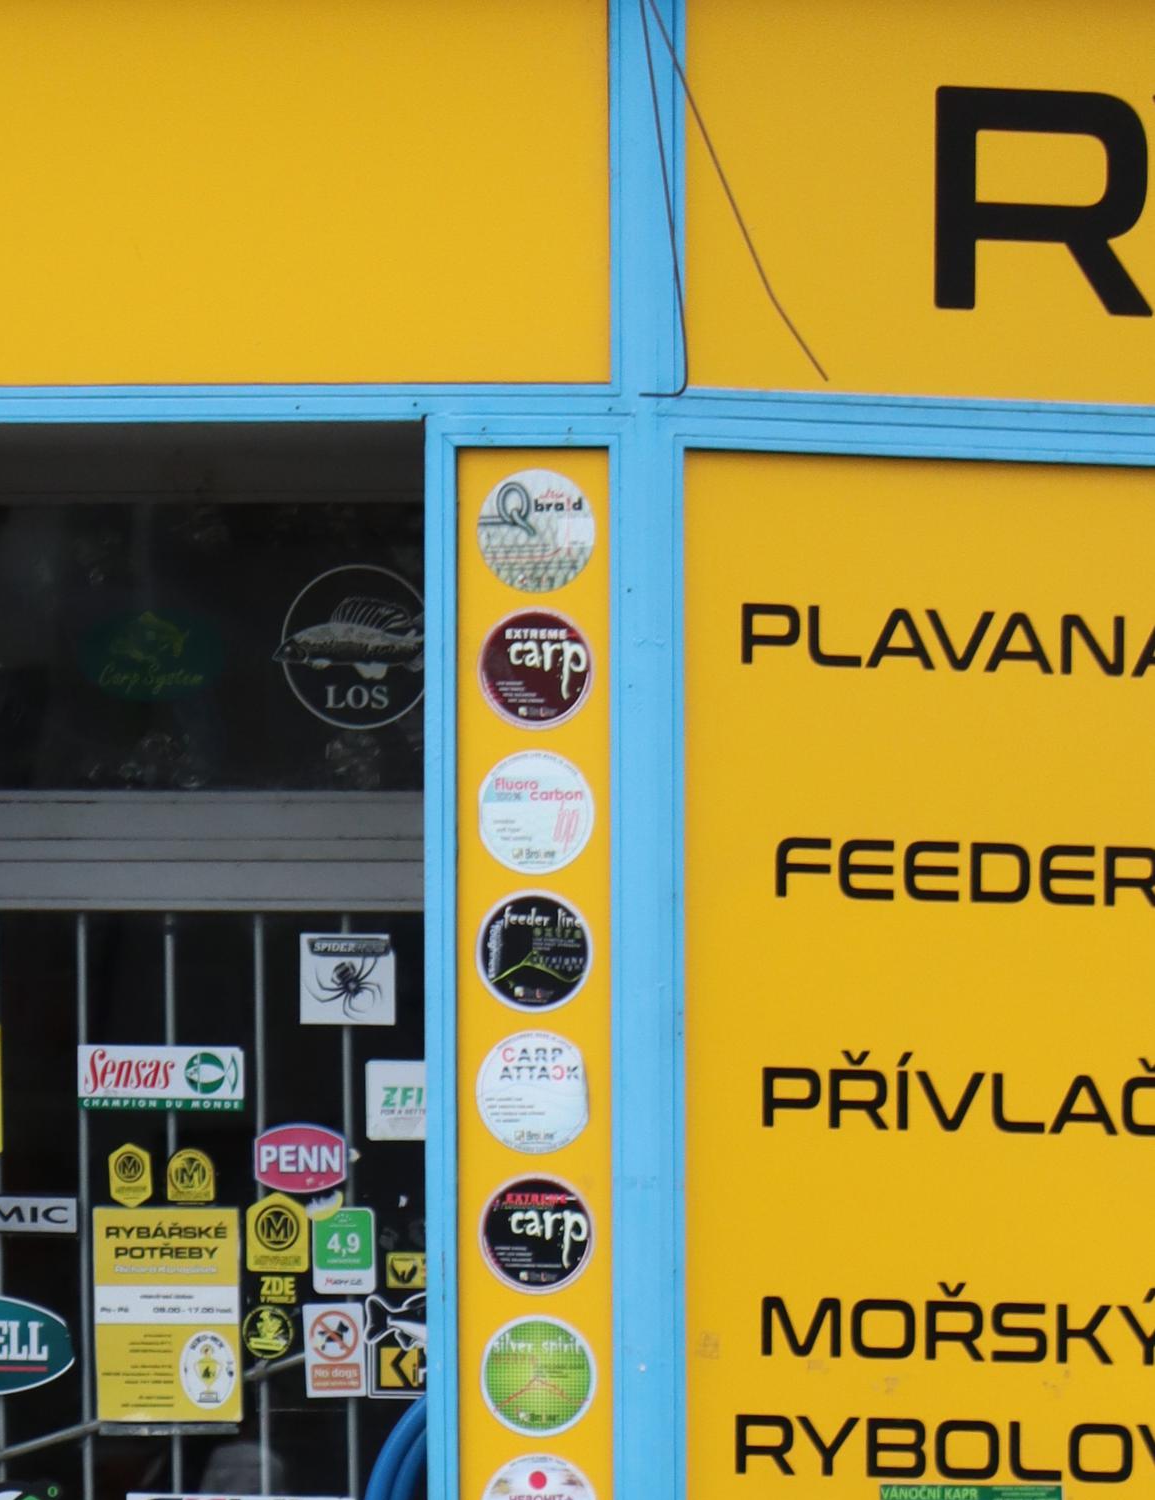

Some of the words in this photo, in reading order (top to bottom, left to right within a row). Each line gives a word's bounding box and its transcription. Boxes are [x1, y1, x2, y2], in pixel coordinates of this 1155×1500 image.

[934, 85, 1155, 317] R
[505, 628, 567, 640] EXTREME
[508, 639, 588, 700] carp
[325, 685, 390, 710] LOS
[529, 788, 583, 801] carbon
[775, 837, 1155, 907] FEEDER
[503, 904, 551, 928] feeder
[557, 907, 582, 928] line
[501, 1046, 564, 1063] CARP
[84, 1048, 176, 1095] Sensas
[500, 1063, 581, 1081] ATTACK
[83, 1098, 157, 1109] CHAMPION
[165, 1099, 182, 1109] DU
[191, 1100, 240, 1110] MONDE
[381, 1087, 424, 1108] ZFI
[259, 1145, 342, 1174] PENN
[105, 1221, 227, 1239] RYBÁŘSKÉ
[509, 1209, 588, 1268] carp
[114, 1243, 219, 1259] POTŘEBY
[326, 1232, 361, 1257] 4,9
[260, 1276, 296, 1296] ZDE
[734, 1413, 1155, 1484] RYBOLO
[881, 1485, 941, 1500] VÁNOČNÍ
[944, 1487, 979, 1500] KAPR
